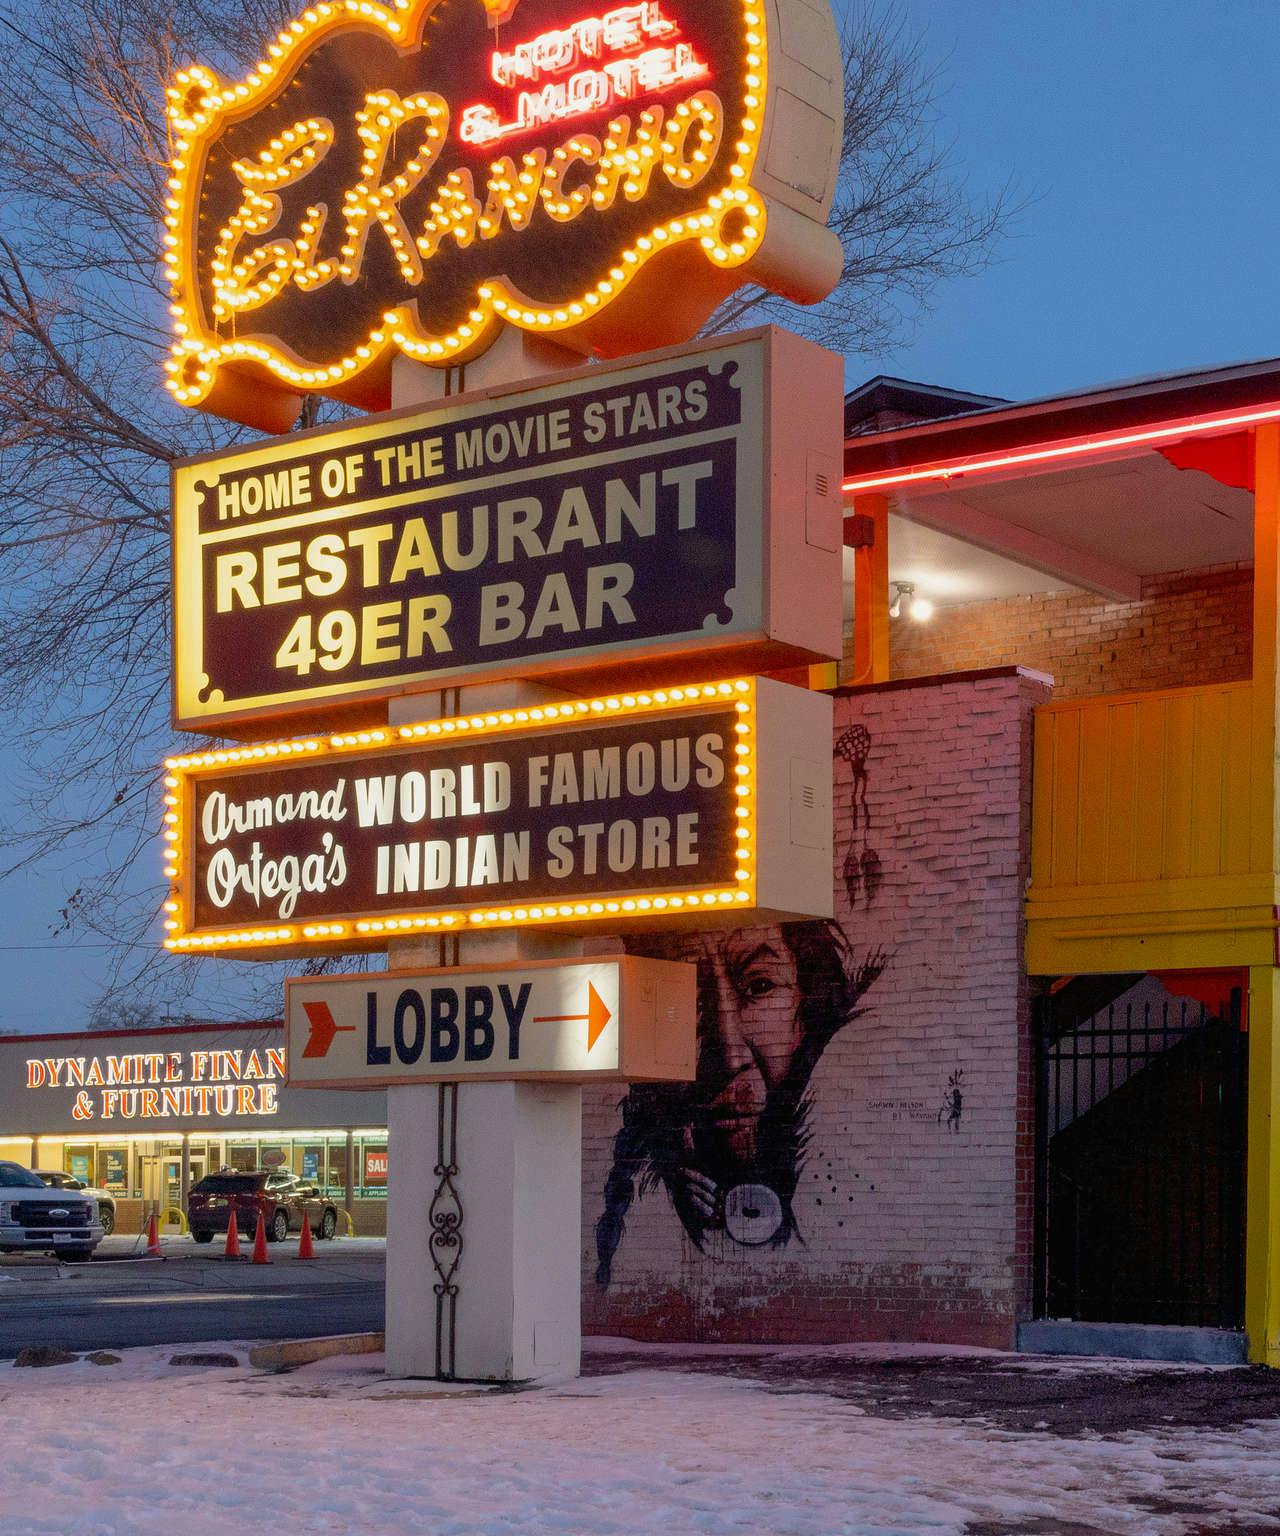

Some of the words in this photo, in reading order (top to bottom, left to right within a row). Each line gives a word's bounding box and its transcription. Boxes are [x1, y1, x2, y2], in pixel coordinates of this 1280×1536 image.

[492, 1, 681, 88] HOTEL
[460, 104, 502, 147] &
[517, 43, 708, 126] MOTEL
[340, 89, 724, 285] RANCHO
[218, 466, 312, 520] HOME
[321, 454, 364, 498] OF
[374, 437, 444, 487] THE
[455, 409, 571, 471] MOVIE
[583, 380, 708, 443] STARS
[216, 460, 713, 613] RESTAURANT
[276, 594, 453, 675] 49ER
[479, 562, 636, 647] BAR
[202, 778, 347, 845] Armand
[355, 761, 511, 827] WORLD
[528, 733, 725, 808] FAMOUS
[207, 832, 347, 920] Ortega's
[376, 830, 530, 895] INDIAN
[547, 812, 699, 879] STORE
[367, 983, 533, 1065] LOBBY
[26, 1052, 183, 1089] DYNAMITE
[72, 1090, 93, 1121] &
[101, 1083, 278, 1119] FURNITURE
[367, 1159, 388, 1173] SAL
